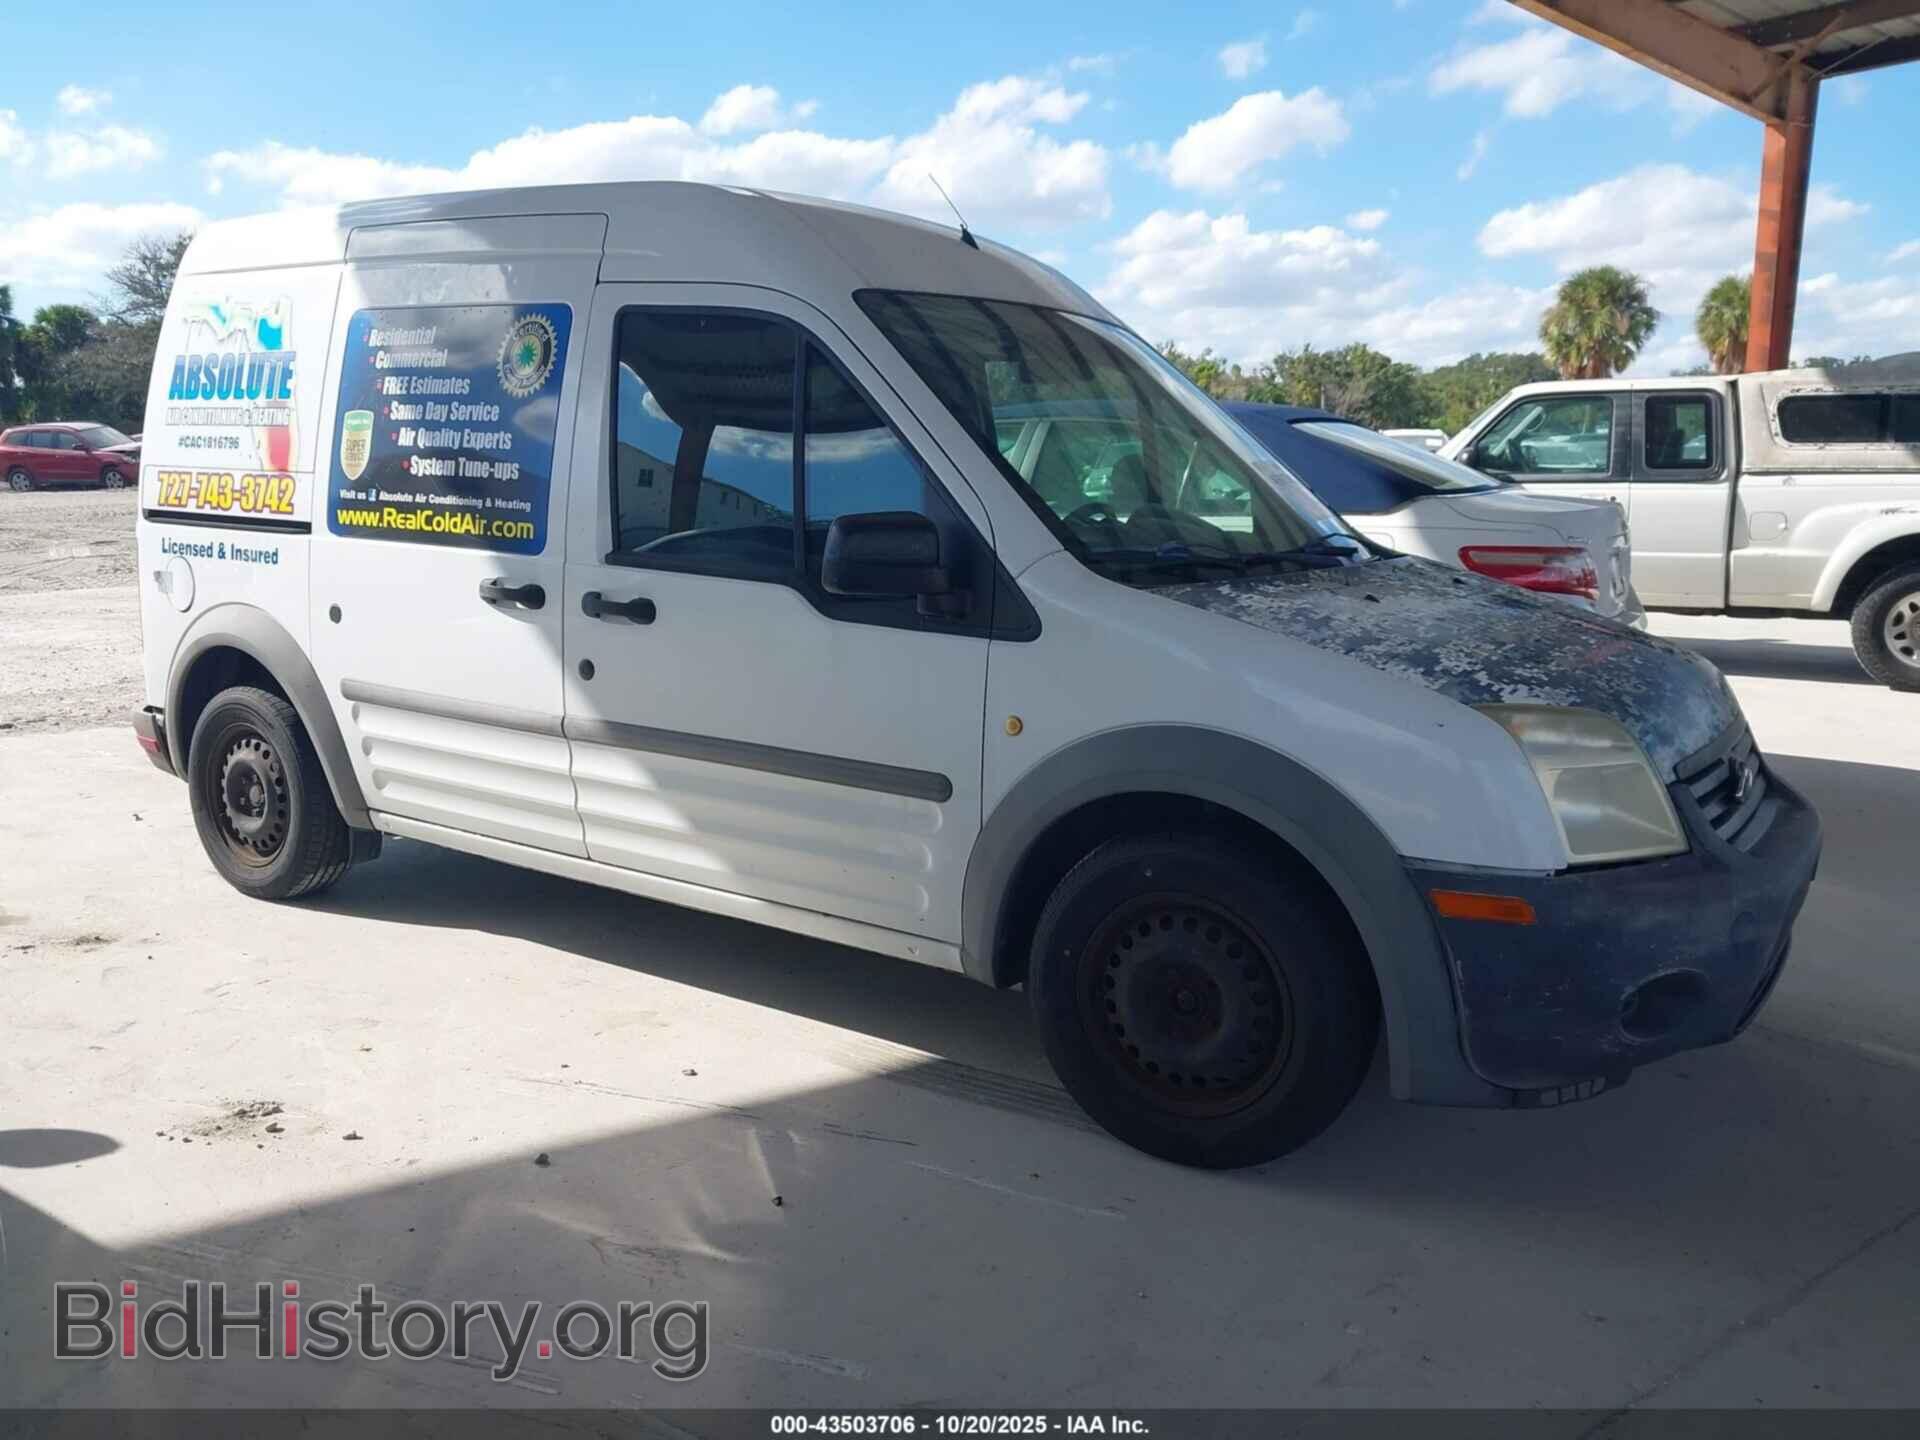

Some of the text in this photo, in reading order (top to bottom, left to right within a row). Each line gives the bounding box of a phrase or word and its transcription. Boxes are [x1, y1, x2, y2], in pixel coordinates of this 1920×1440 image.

[368, 326, 436, 347] Residential
[375, 349, 448, 369] Commercial
[168, 351, 297, 401] ABSOLUTE
[382, 376, 471, 395] FREE Estimates
[390, 401, 500, 422] Same Day Service
[398, 427, 513, 450] Air Quality Experts
[410, 455, 520, 481] System Tune-ups
[157, 470, 296, 515] 727-743-3742
[339, 488, 532, 512] Visit us Absolute Air Conditioning & Heating
[336, 507, 535, 540] www.RealColdAir.com
[161, 537, 279, 564] Licensed & Insured
